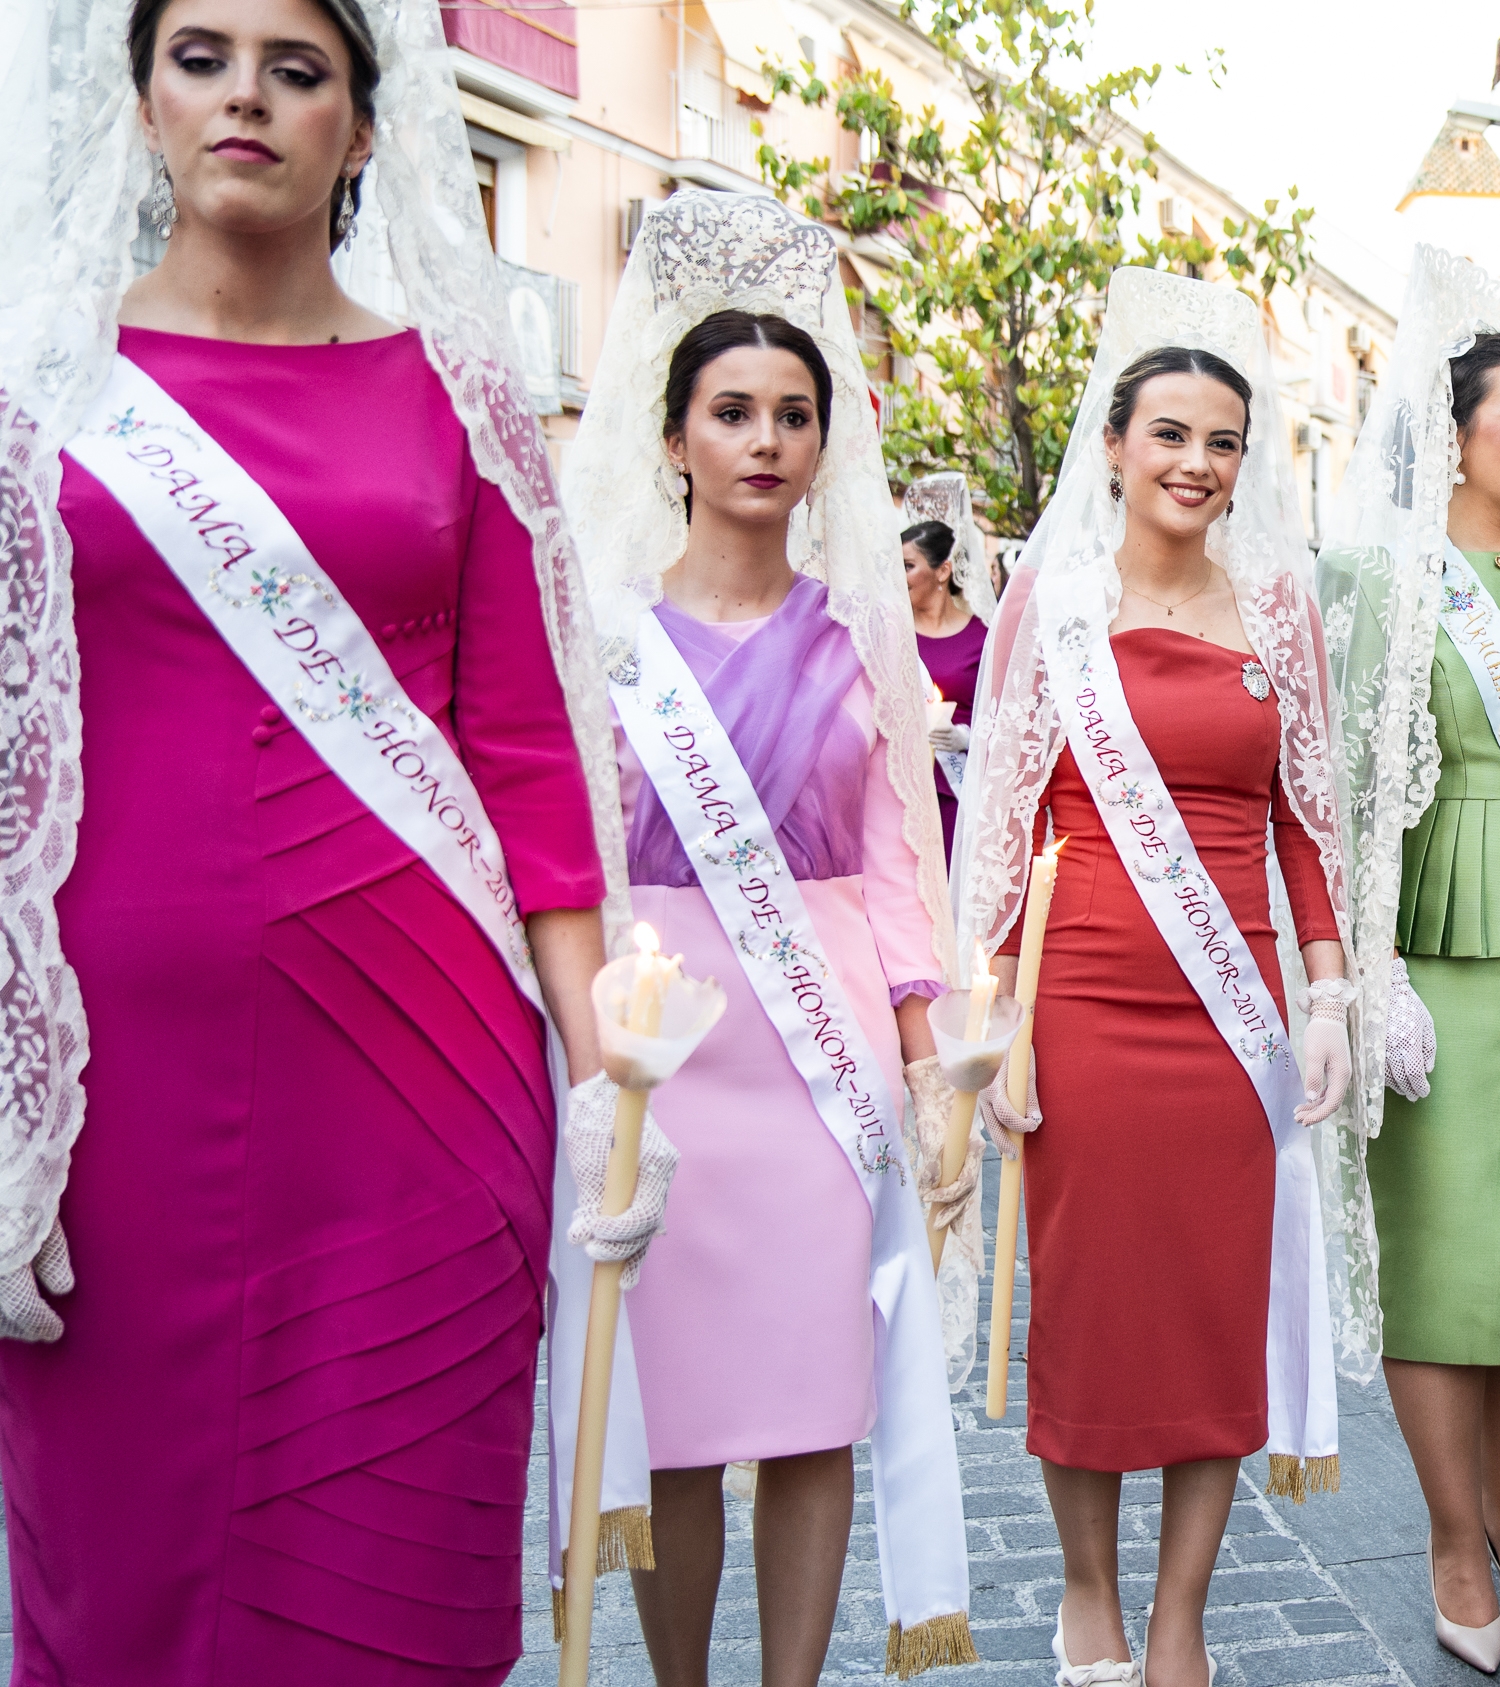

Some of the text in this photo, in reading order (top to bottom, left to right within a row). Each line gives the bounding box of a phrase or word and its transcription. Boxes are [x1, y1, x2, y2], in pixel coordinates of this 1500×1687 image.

[126, 444, 257, 572] DAMA
[273, 617, 345, 685] DE
[663, 725, 885, 1139] DAMA DE HONOR-2017
[1076, 688, 1268, 1033] DAMA DE HONOR-2017
